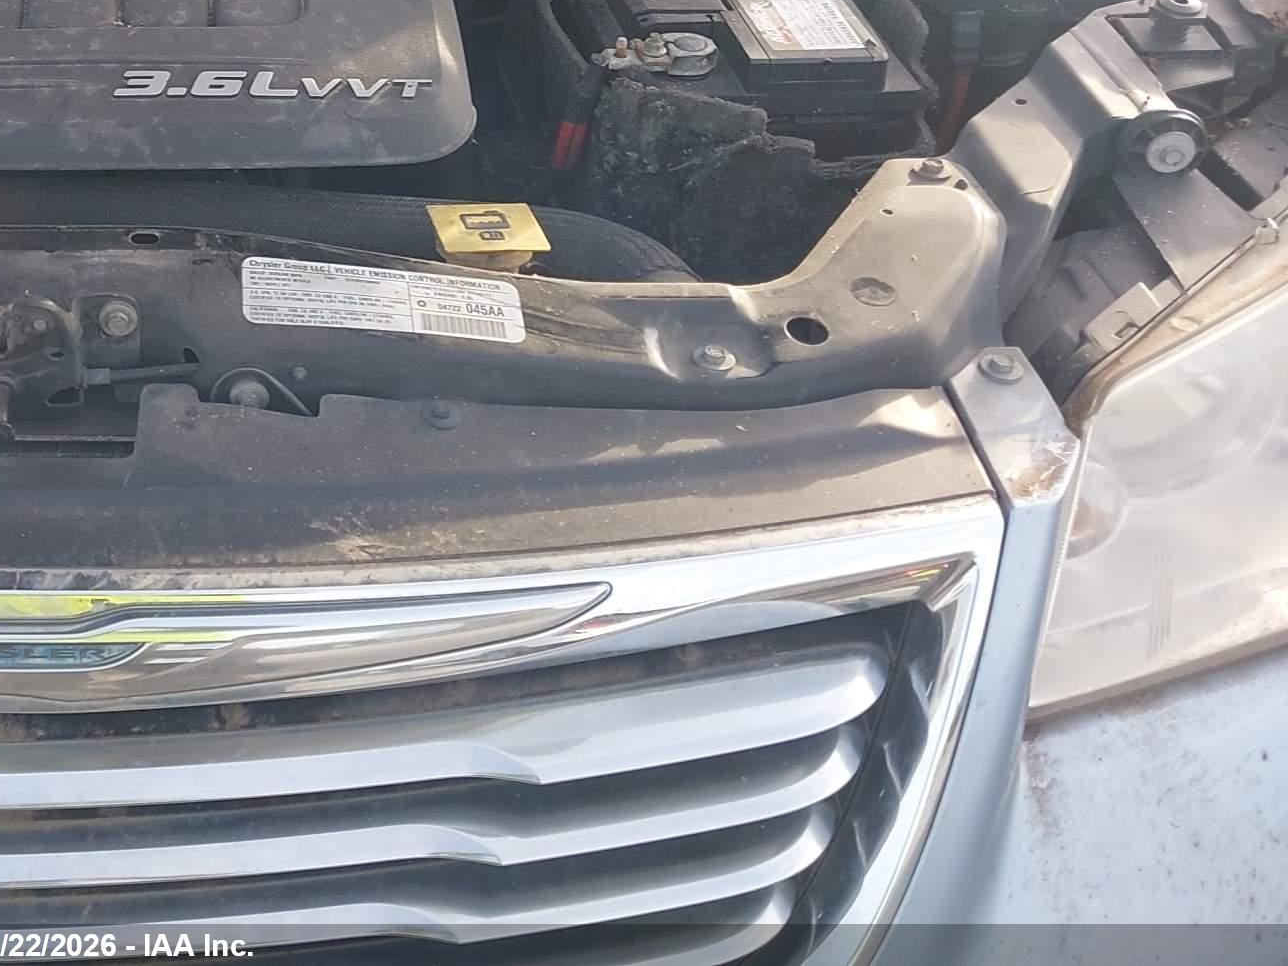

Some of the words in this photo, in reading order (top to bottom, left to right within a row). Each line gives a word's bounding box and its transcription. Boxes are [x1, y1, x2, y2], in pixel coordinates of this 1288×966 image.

[249, 260, 282, 269] Chrysler
[284, 262, 308, 271] Group
[334, 267, 366, 276] VEHICLE
[369, 270, 406, 280] EMISSION
[409, 274, 444, 284] CONTROL
[446, 278, 501, 290] INFORMATION
